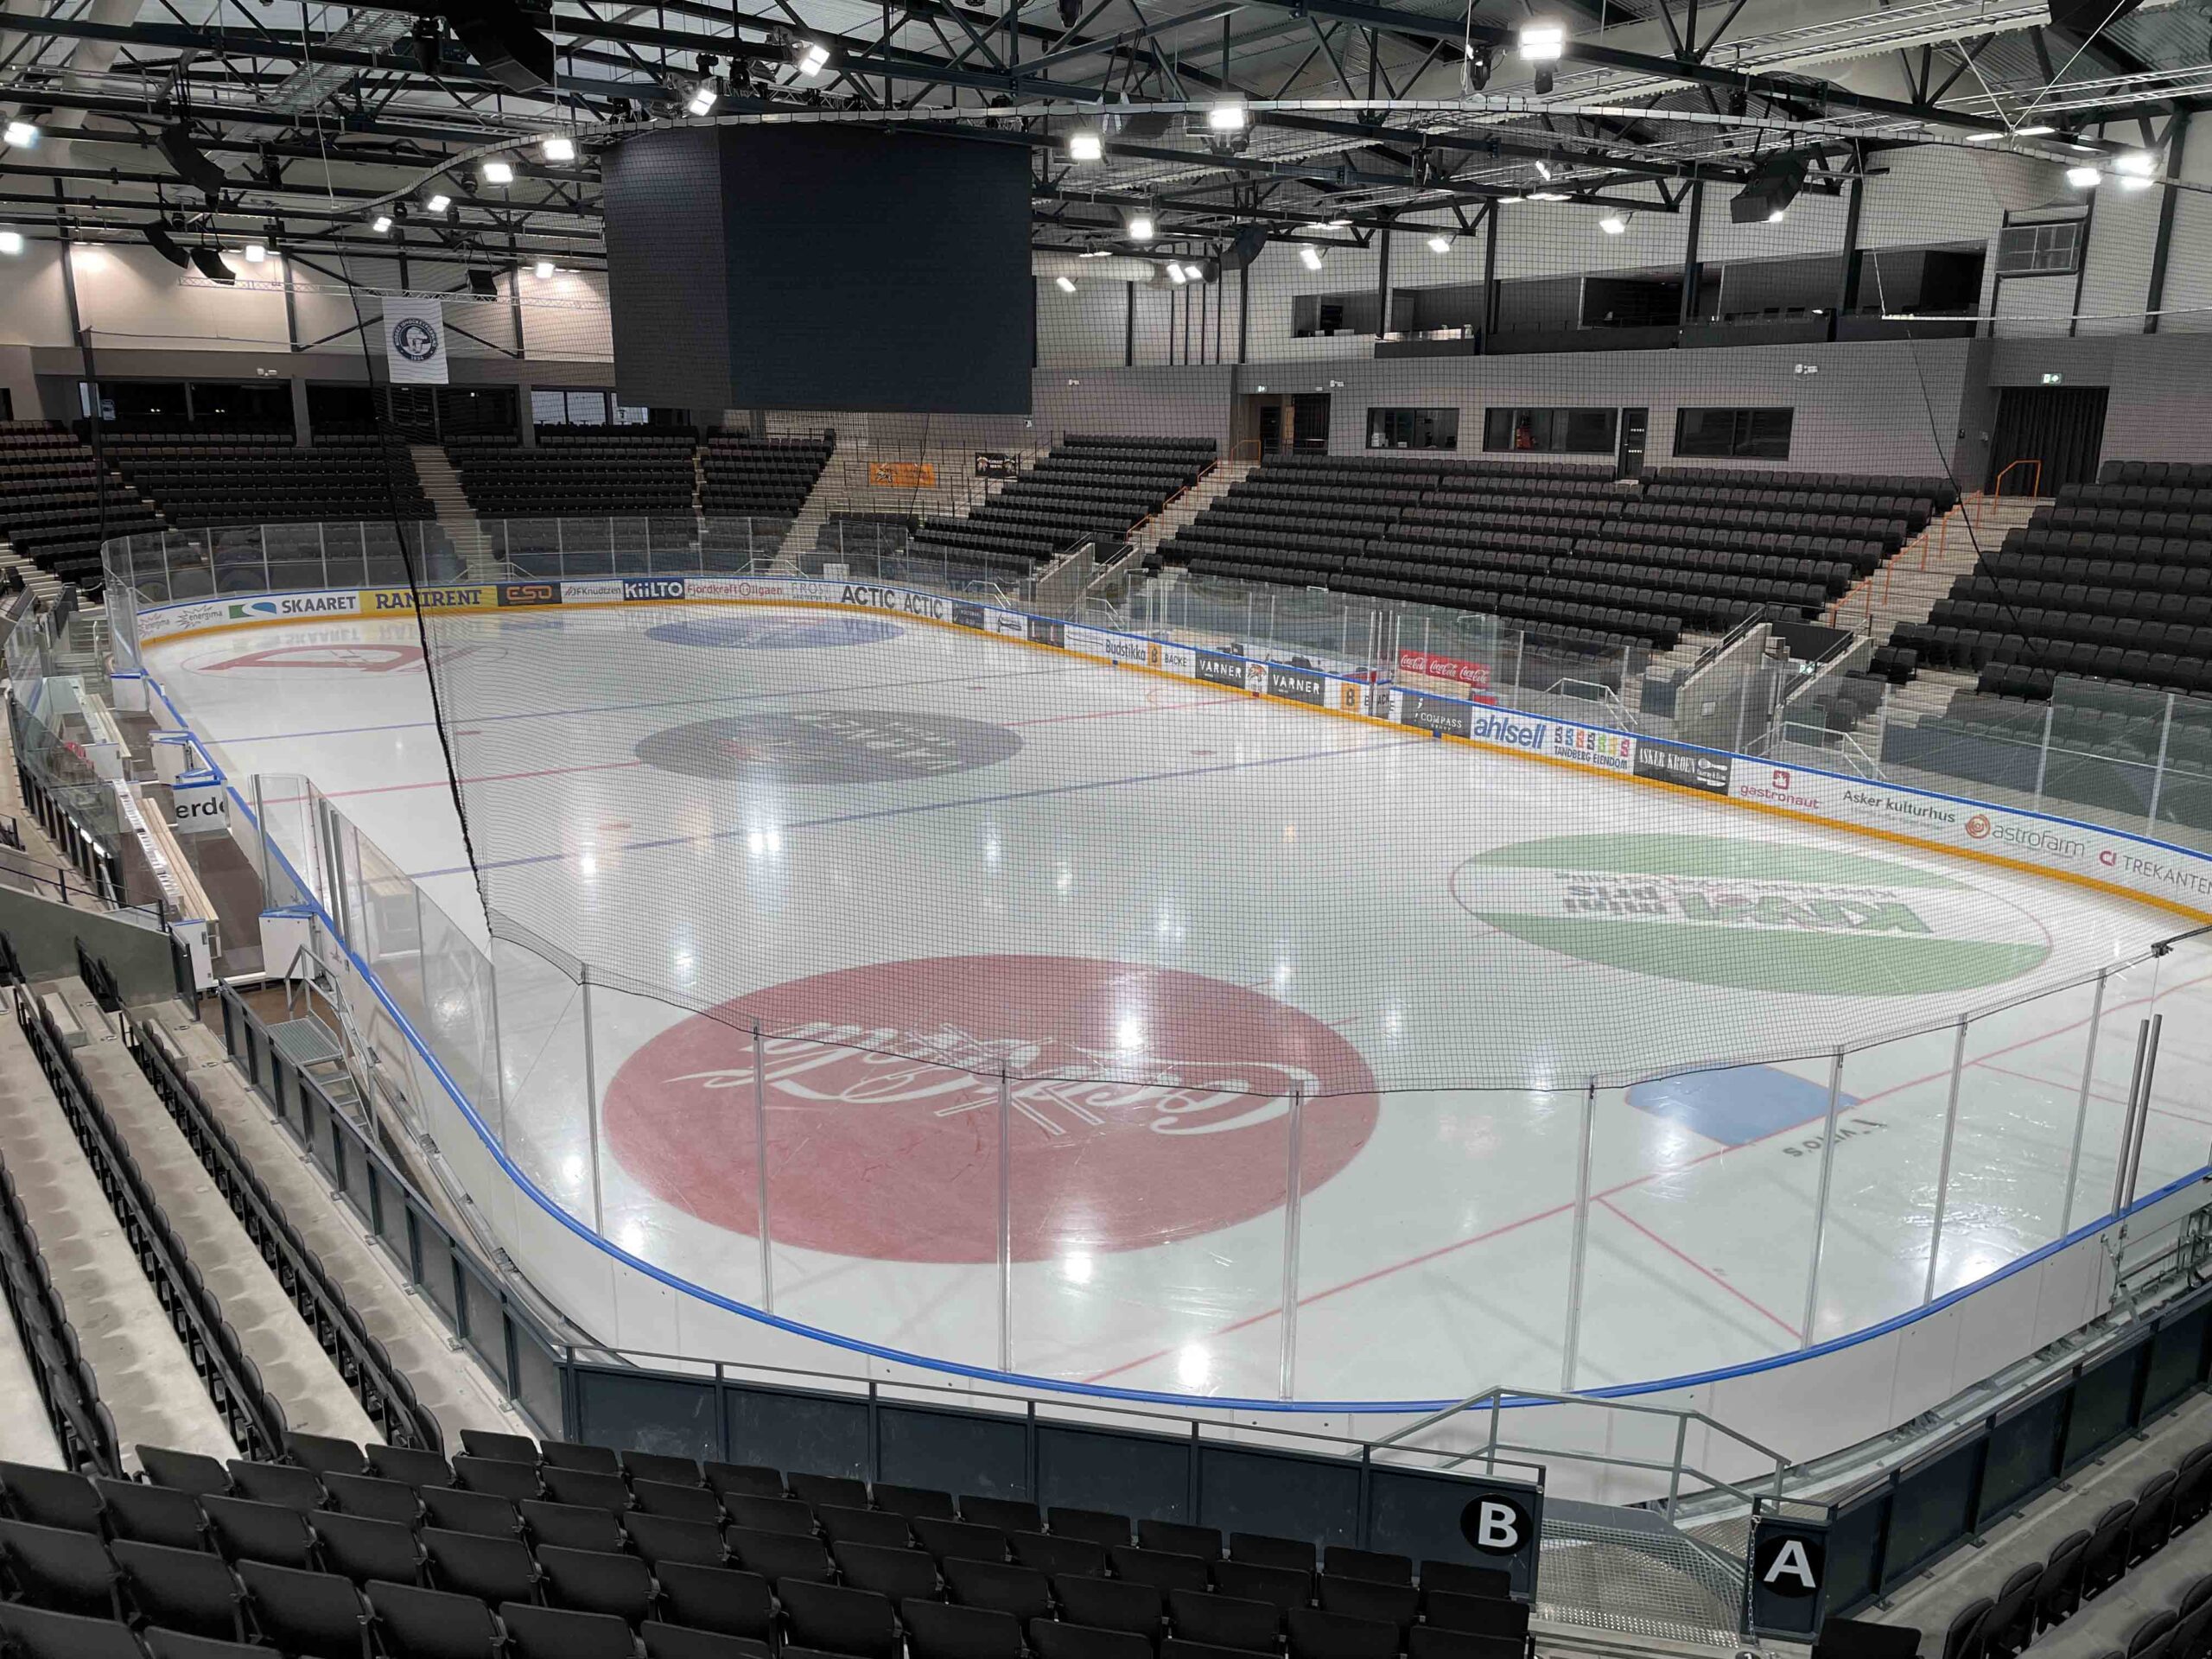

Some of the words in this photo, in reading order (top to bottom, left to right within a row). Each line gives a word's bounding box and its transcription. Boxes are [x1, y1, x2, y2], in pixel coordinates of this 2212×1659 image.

[625, 582, 683, 599] KiiLTO
[688, 583, 738, 596] Fjordkraft
[842, 585, 895, 609] ACTIC
[188, 610, 223, 621] energima
[282, 596, 356, 613] SKAARET
[904, 594, 944, 619] ACTIC
[1105, 639, 1146, 661] Budstikka
[1165, 654, 1187, 667] BACKE
[1199, 659, 1242, 678] VARNER
[1273, 674, 1319, 695] VARNER
[1421, 712, 1462, 728] COMPASS
[1474, 715, 1547, 749] ahlsell
[1554, 746, 1591, 762] TANDBERG
[1592, 753, 1628, 769] EIENDOM
[1740, 784, 1820, 809] gastronaut
[1843, 790, 1883, 807] Asker
[1886, 798, 1956, 823] kulturhus
[1993, 823, 2085, 857] astrofarm
[1478, 1501, 1518, 1548] B
[1764, 1540, 1816, 1588] A
